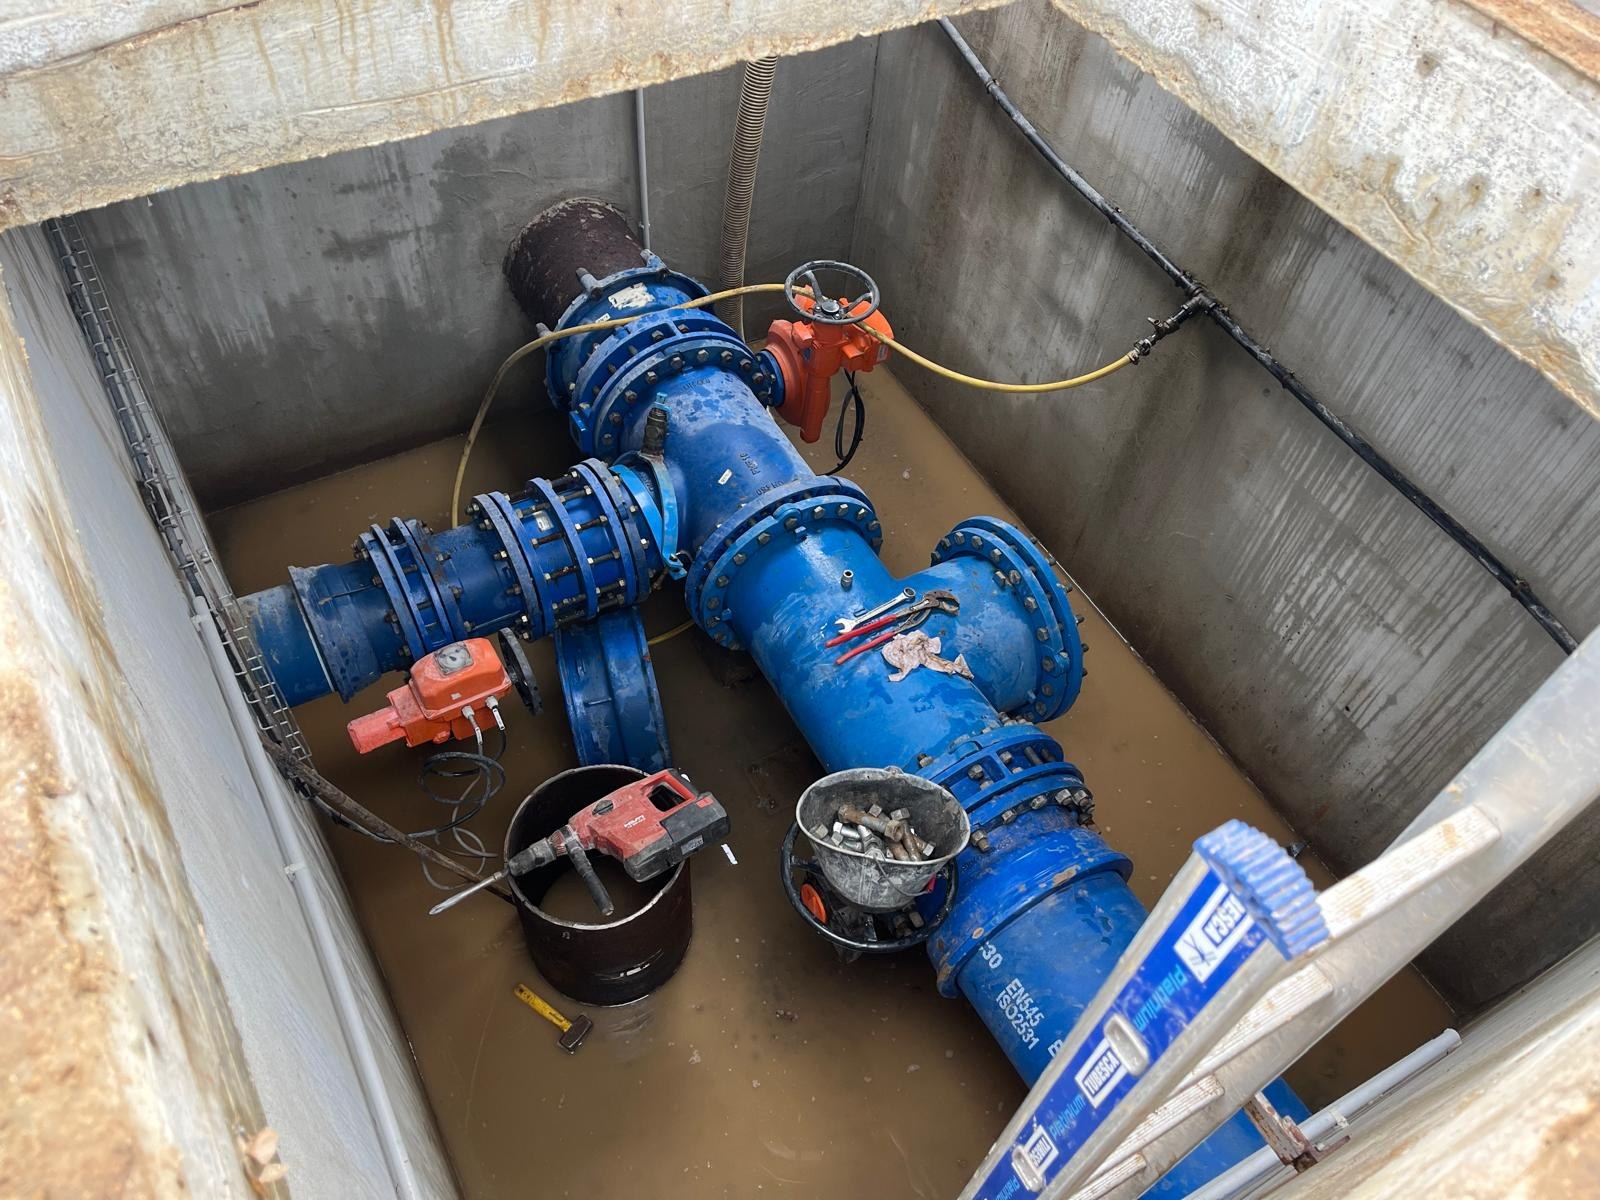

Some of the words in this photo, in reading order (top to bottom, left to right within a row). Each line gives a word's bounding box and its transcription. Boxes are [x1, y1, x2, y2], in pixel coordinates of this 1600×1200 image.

[1203, 893, 1247, 945] ESCA
[979, 941, 1003, 969] 30
[996, 989, 1040, 1050] ISO2531
[1005, 977, 1045, 1027] EN545
[1132, 963, 1188, 1032] Platinium
[1083, 1049, 1121, 1096] TUBESCA
